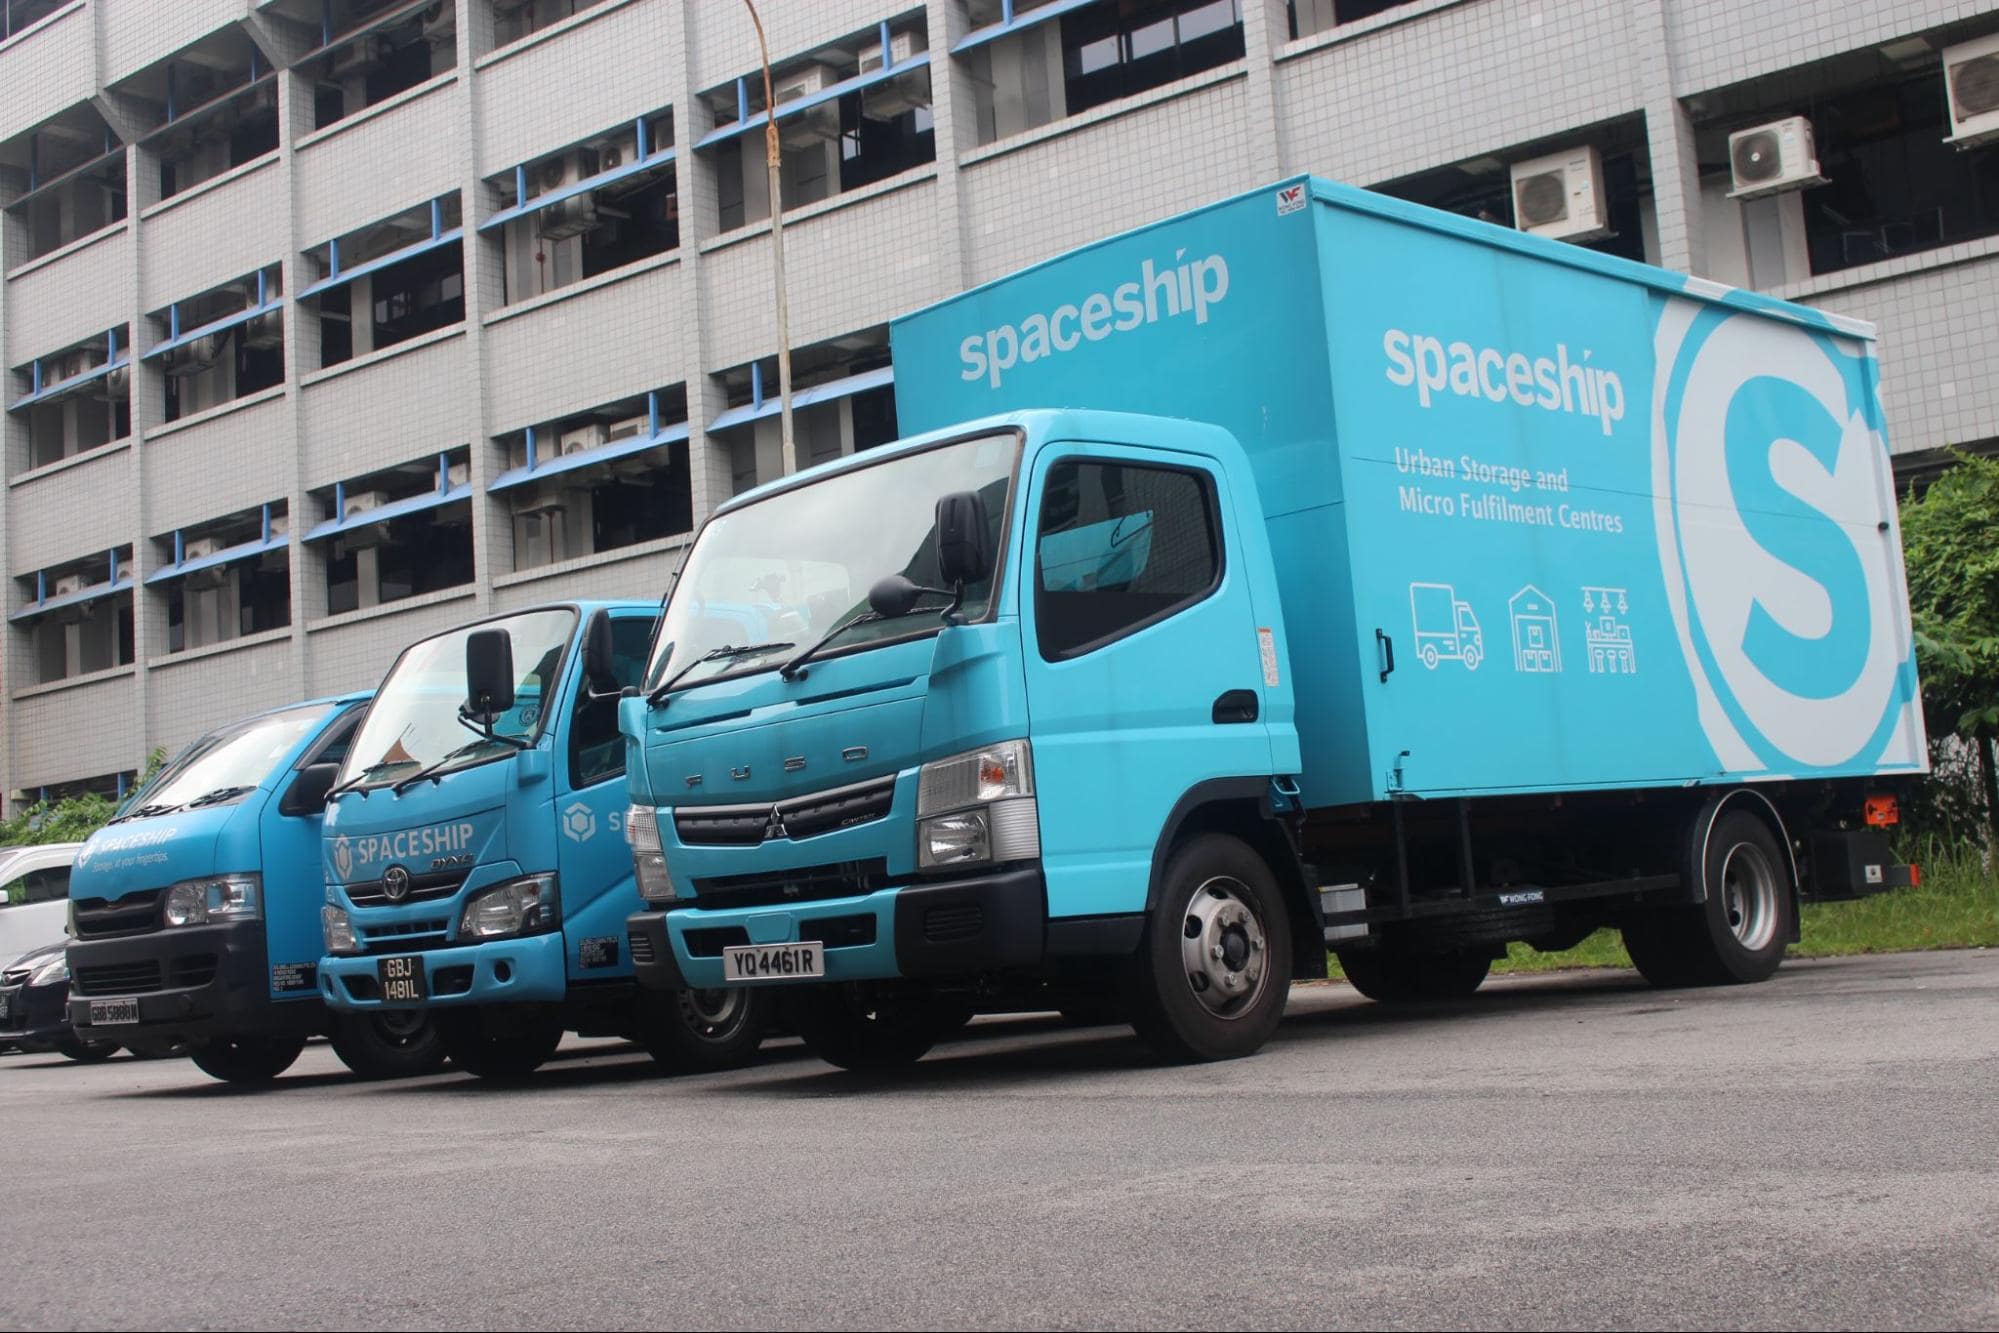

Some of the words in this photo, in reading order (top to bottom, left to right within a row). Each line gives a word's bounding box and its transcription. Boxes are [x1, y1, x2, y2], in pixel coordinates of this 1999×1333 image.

[960, 248, 1229, 389] spaceship
[1384, 329, 1625, 436] spaceship
[1395, 446, 1455, 478] Urban
[1460, 455, 1531, 492] Storage
[1536, 468, 1569, 492] and
[1398, 486, 1455, 516] Micro
[1460, 493, 1554, 526] Fulfilment
[1558, 504, 1623, 533] Centres
[685, 746, 869, 788] FUSO
[358, 823, 473, 865] SPACESHIP
[387, 958, 412, 977] GBJ
[734, 949, 813, 976] YQ4461R
[384, 979, 419, 1000] 1481L
